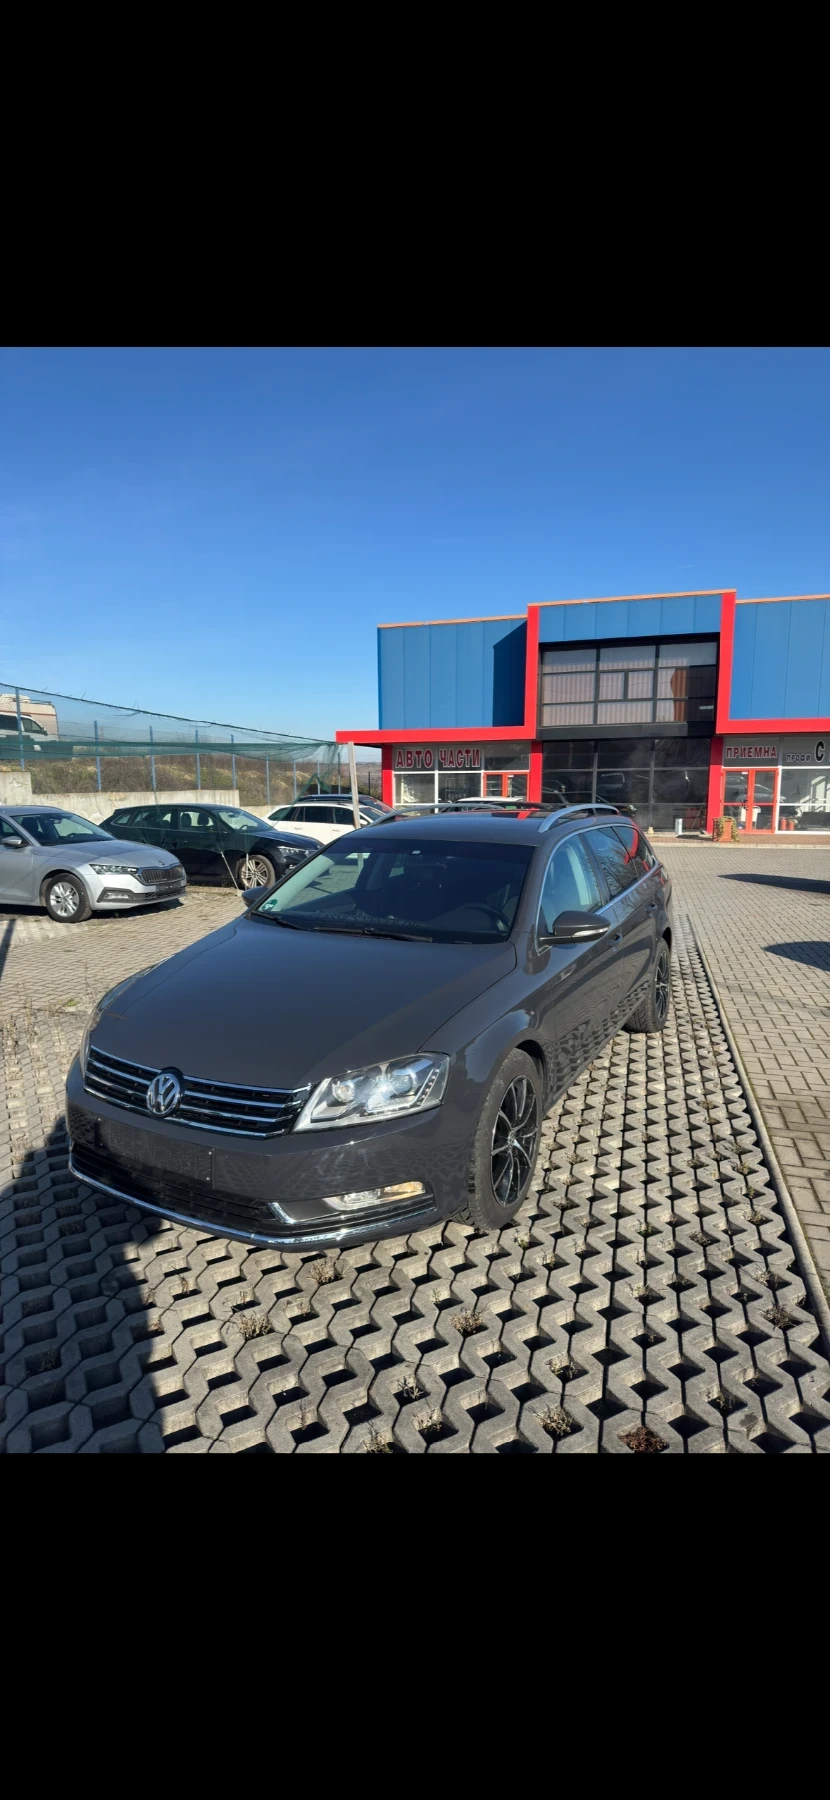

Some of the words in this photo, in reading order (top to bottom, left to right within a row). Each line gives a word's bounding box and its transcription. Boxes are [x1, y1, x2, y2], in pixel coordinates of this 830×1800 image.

[395, 749, 433, 768] АВТО
[439, 749, 480, 768] ЧАСТИ
[725, 746, 777, 758] ПРИЕМНА
[786, 753, 811, 763] ПРОФИ
[815, 741, 829, 762] С
